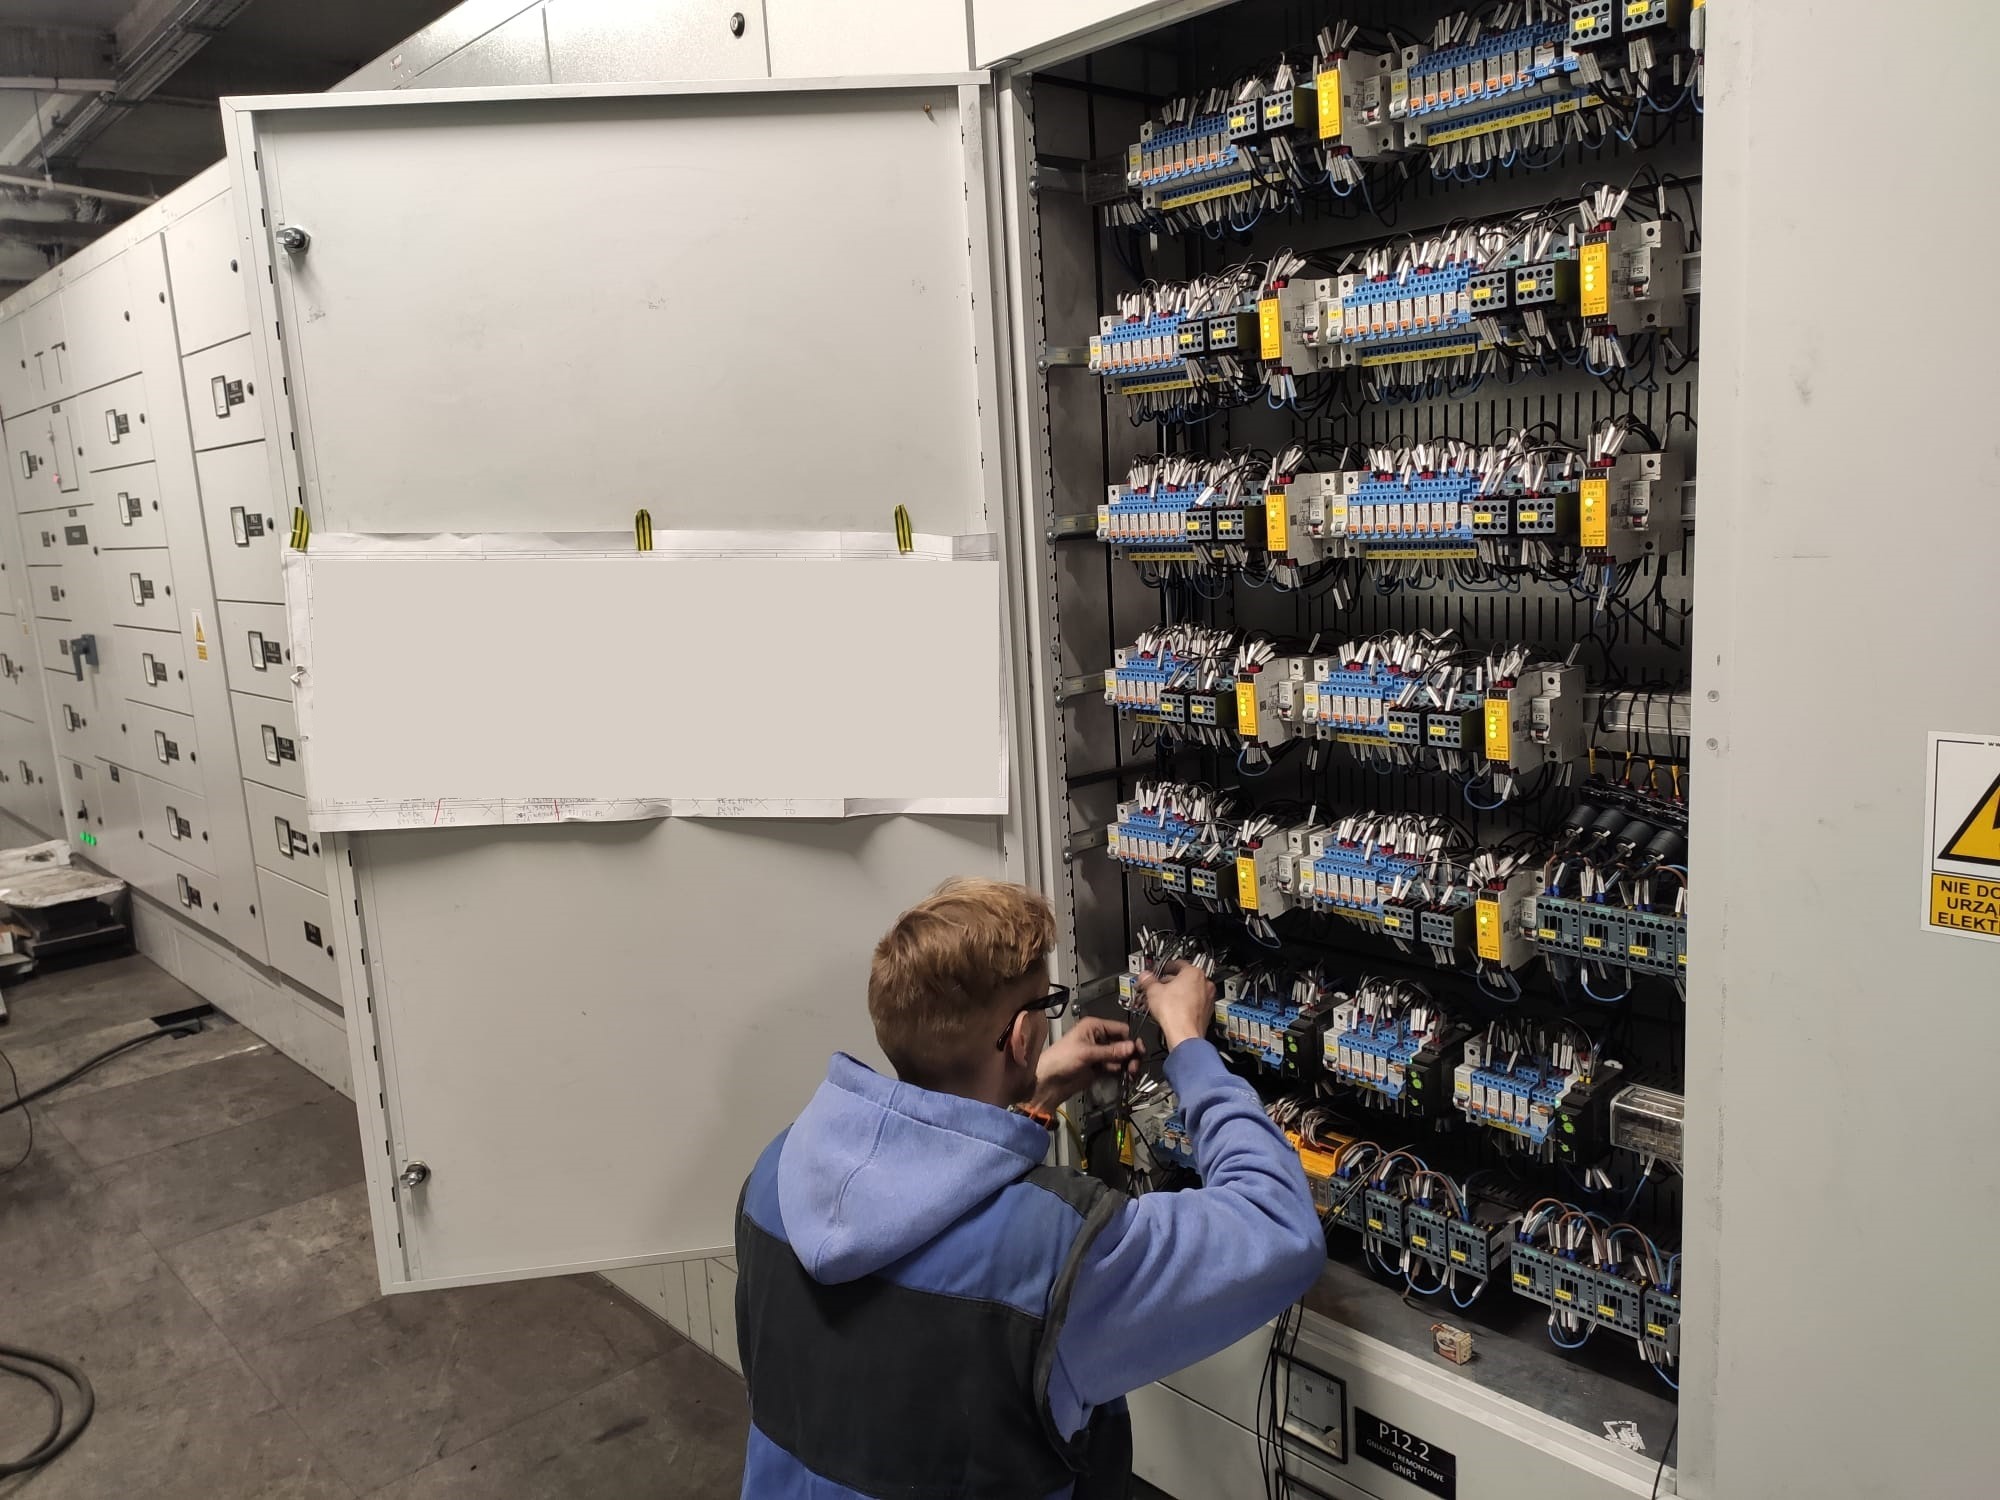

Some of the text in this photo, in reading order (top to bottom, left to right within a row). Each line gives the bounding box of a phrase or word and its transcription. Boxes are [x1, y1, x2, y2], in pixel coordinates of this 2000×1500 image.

[1940, 880, 2000, 900] NIE DO
[1946, 896, 2000, 918] URZĄ
[1938, 912, 2000, 934] ELEKT
[1378, 1422, 1430, 1462] P12.2
[1392, 1462, 1418, 1481] GNR1
[1397, 1452, 1446, 1483] REMONTOWE
